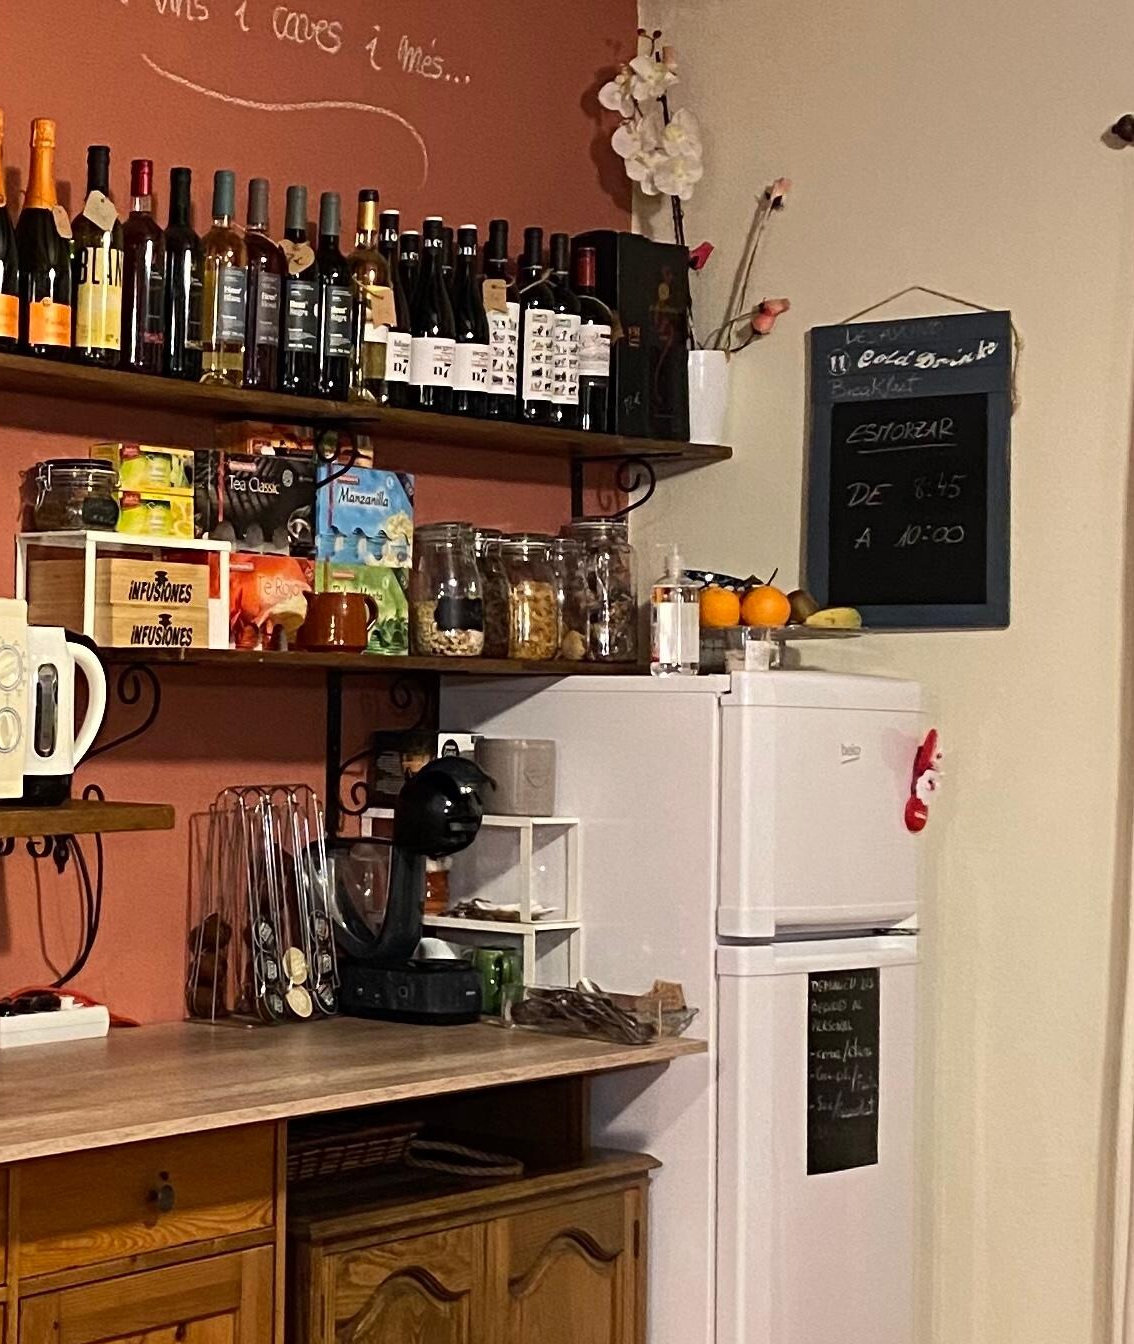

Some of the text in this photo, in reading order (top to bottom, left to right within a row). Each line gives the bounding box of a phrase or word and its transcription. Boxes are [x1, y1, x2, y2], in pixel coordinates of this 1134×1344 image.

[273, 6, 343, 54] caves
[366, 25, 382, 70] i
[857, 349, 915, 369] Cold
[915, 339, 999, 369] Drinks
[846, 417, 954, 444] ESMORZAR
[229, 474, 280, 495] Tea Classic
[338, 487, 389, 507] Manzanilla
[847, 482, 893, 507] DE
[853, 527, 871, 550] A
